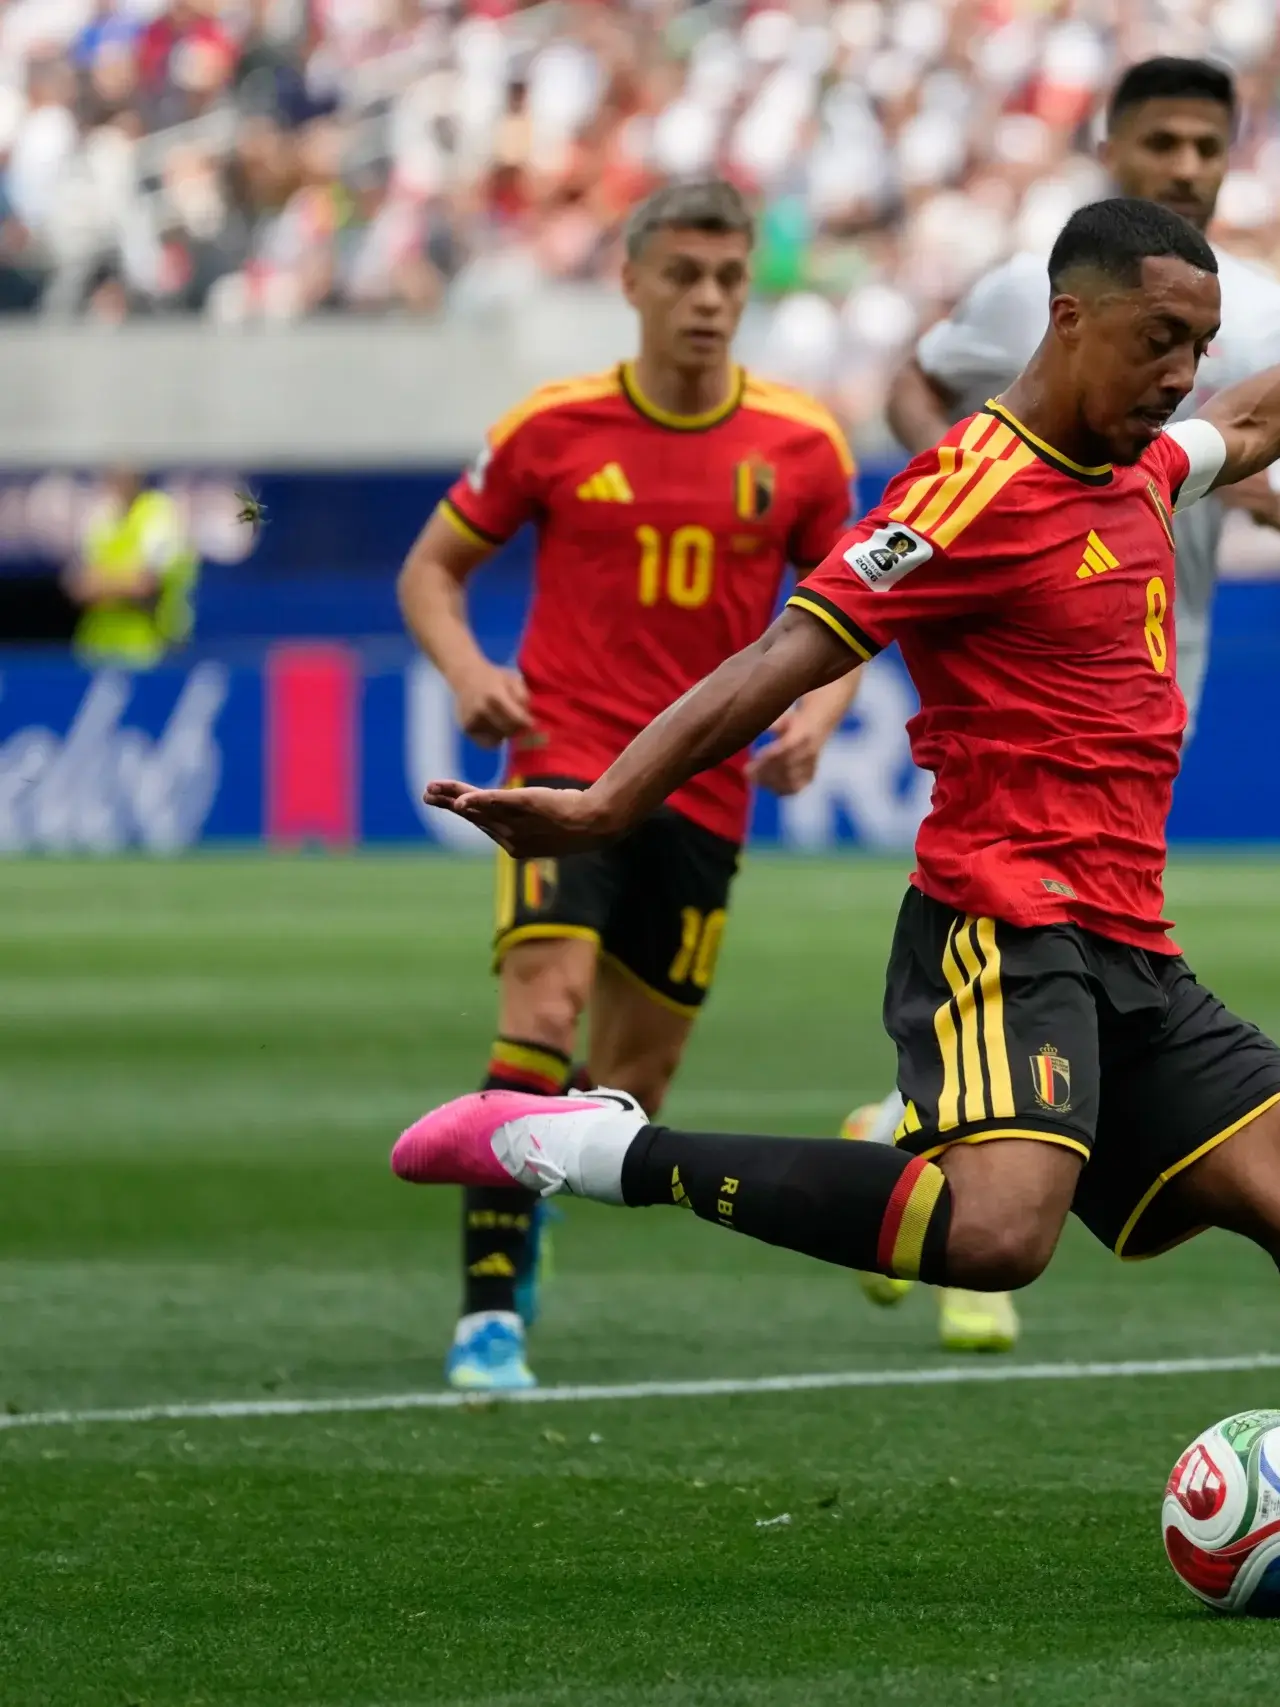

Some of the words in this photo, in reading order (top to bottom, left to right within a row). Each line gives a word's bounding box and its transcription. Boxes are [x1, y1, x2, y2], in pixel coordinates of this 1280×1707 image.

[637, 525, 714, 609] 10
[856, 558, 879, 582] 2026
[861, 554, 875, 570] WORLD
[874, 552, 887, 565] FIFA
[1144, 576, 1167, 674] 8
[717, 1176, 739, 1225] RB
